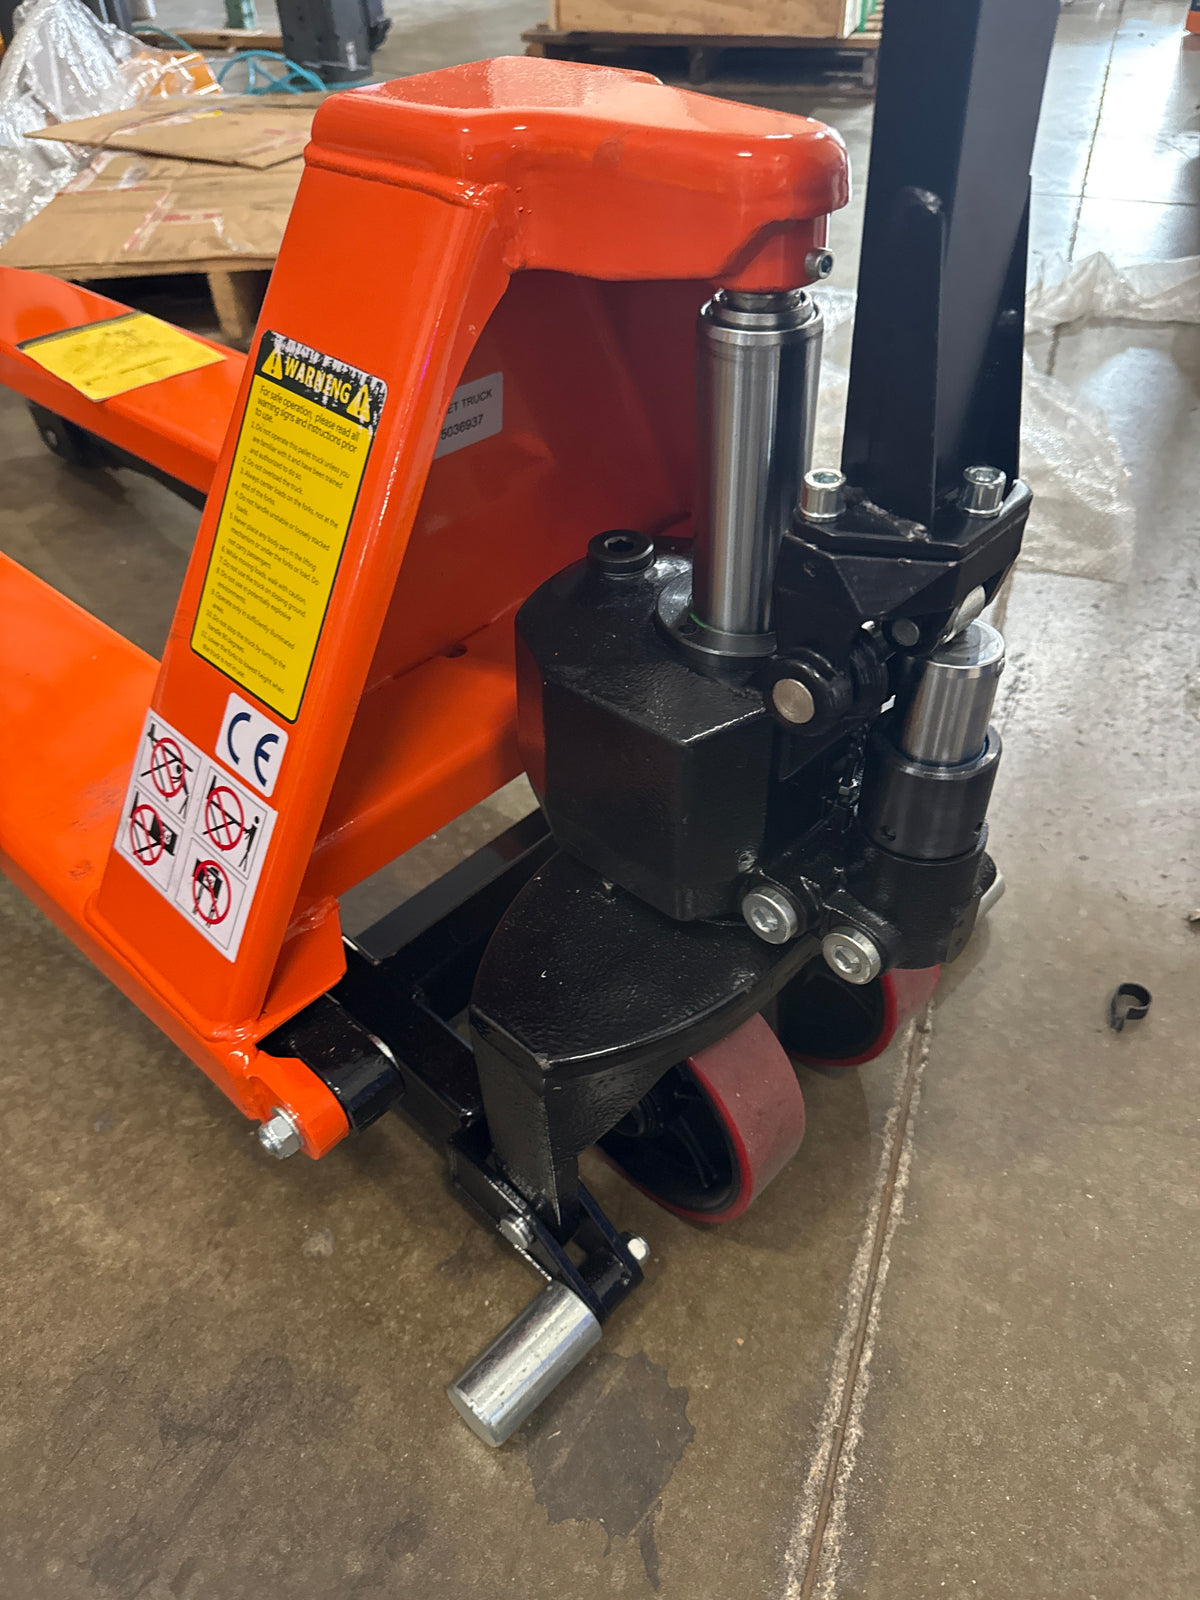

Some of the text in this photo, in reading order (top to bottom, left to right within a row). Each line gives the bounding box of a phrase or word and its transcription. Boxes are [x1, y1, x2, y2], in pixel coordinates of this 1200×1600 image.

[285, 356, 352, 404] WARNING
[462, 389, 492, 408] TRUCK
[254, 407, 262, 417] to
[257, 398, 357, 453] warning signs and instructions prior
[259, 384, 271, 396] For
[269, 392, 283, 404] safe
[314, 413, 336, 430] please
[335, 424, 352, 438] read
[350, 431, 360, 442] all
[227, 711, 280, 788] CE
